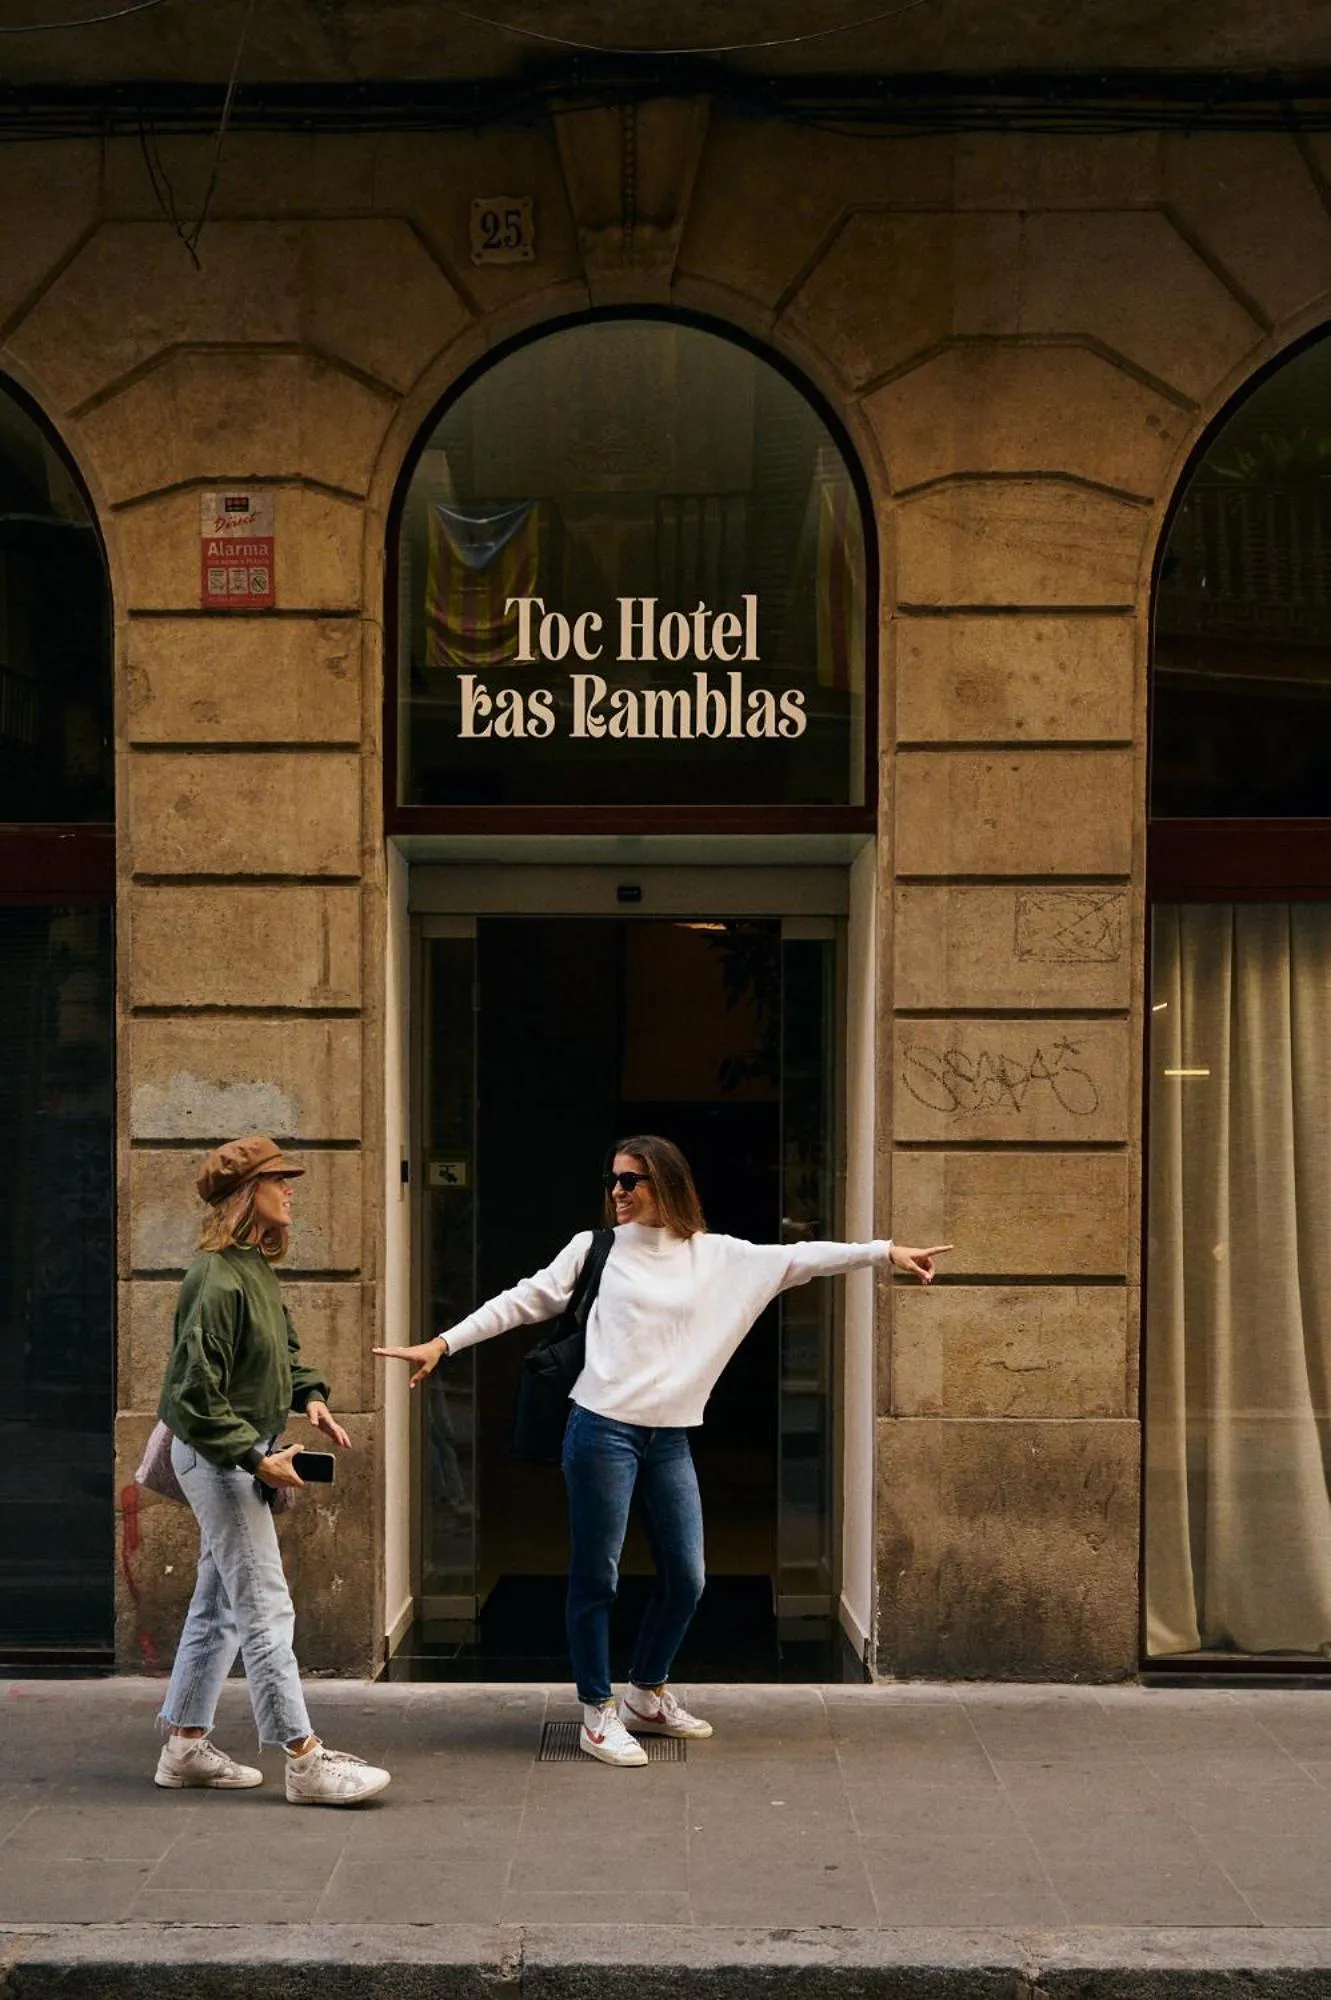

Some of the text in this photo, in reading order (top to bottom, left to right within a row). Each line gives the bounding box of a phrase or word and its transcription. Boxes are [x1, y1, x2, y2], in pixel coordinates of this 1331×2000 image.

[481, 210, 522, 249] 25
[207, 541, 269, 557] Alarma
[504, 594, 761, 661] Toc Hotel
[457, 671, 807, 738] Las Ramblas
